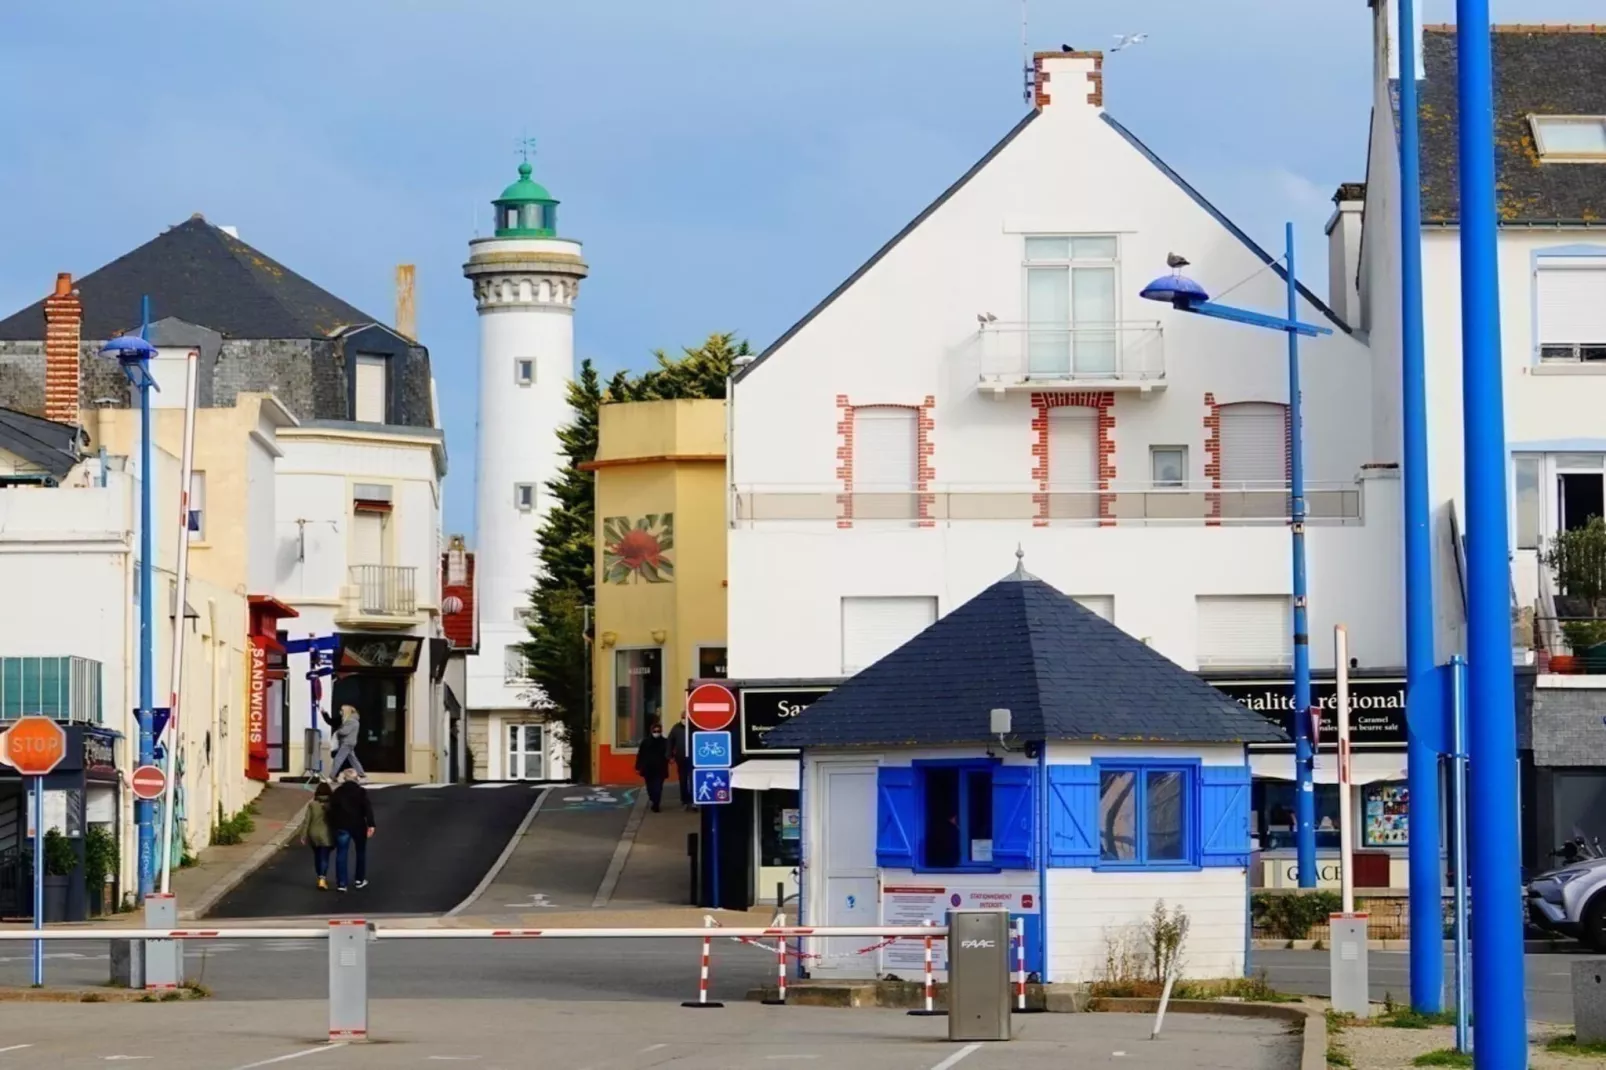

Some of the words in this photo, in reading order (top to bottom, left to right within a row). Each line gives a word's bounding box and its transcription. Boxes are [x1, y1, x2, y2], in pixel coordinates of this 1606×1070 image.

[250, 648, 264, 743] SANDWICHS
[1229, 692, 1296, 710] cialité
[1318, 690, 1406, 714] réional
[12, 737, 58, 753] STOP
[1287, 865, 1342, 881] GCE
[961, 939, 995, 948] FAAC
